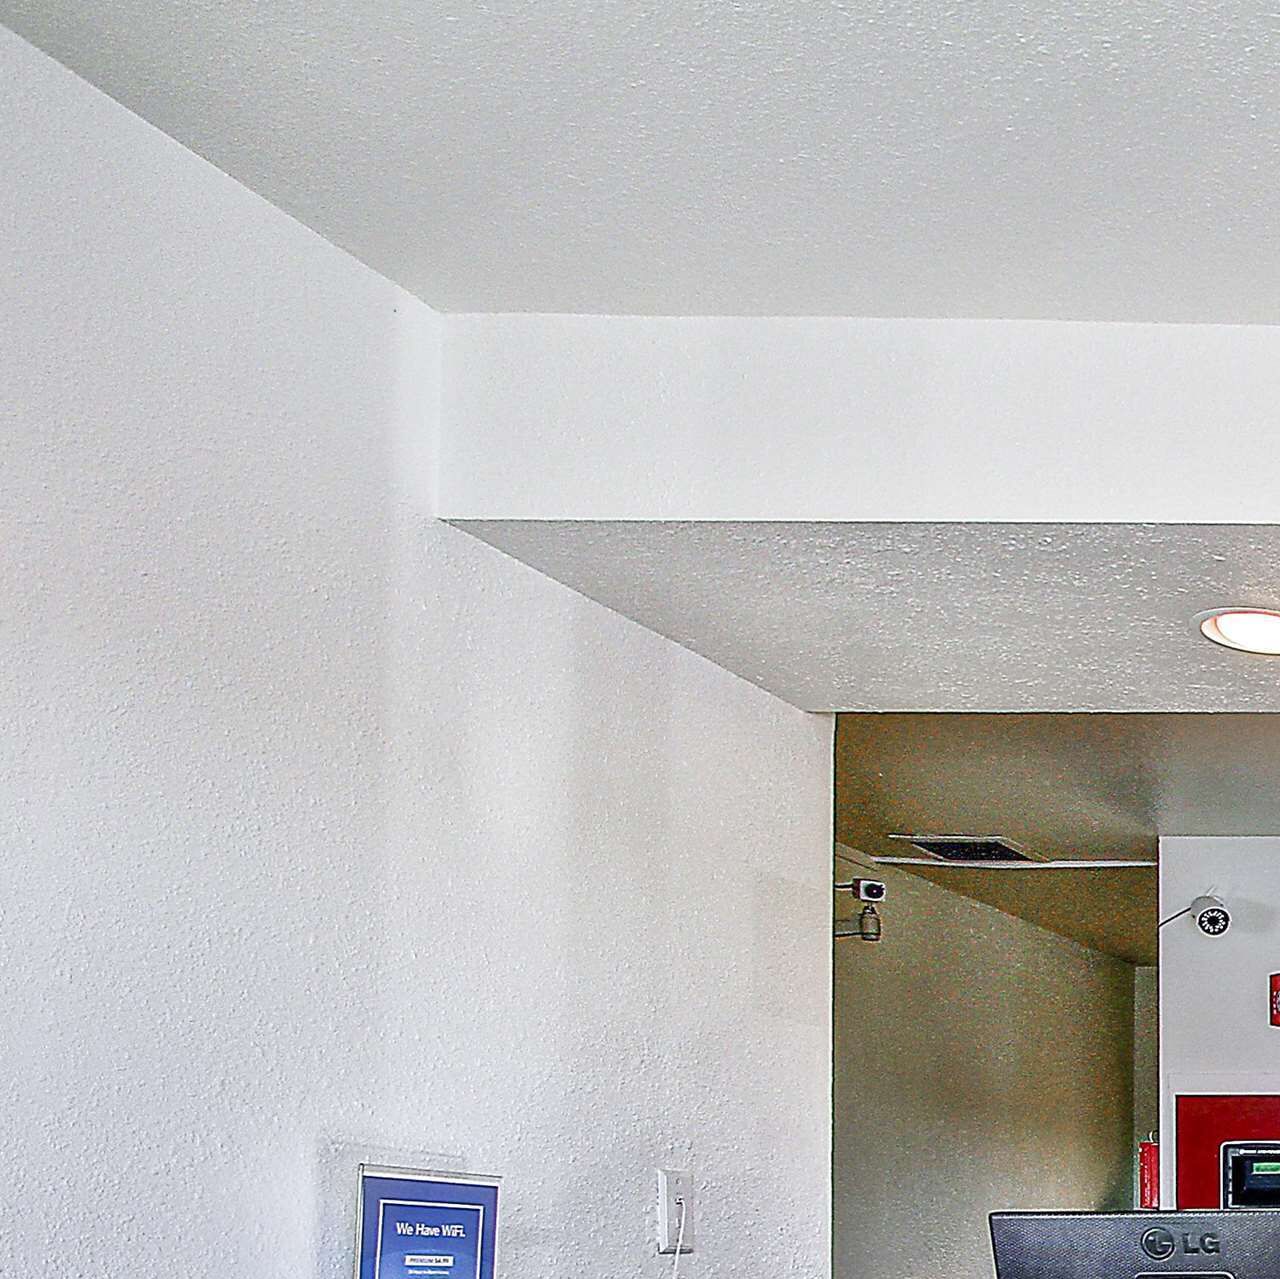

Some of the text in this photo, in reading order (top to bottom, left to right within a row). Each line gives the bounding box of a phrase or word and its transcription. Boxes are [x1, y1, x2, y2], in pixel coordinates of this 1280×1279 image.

[395, 1222, 413, 1236] We
[415, 1222, 440, 1237] Have
[1182, 1231, 1221, 1255] LG
